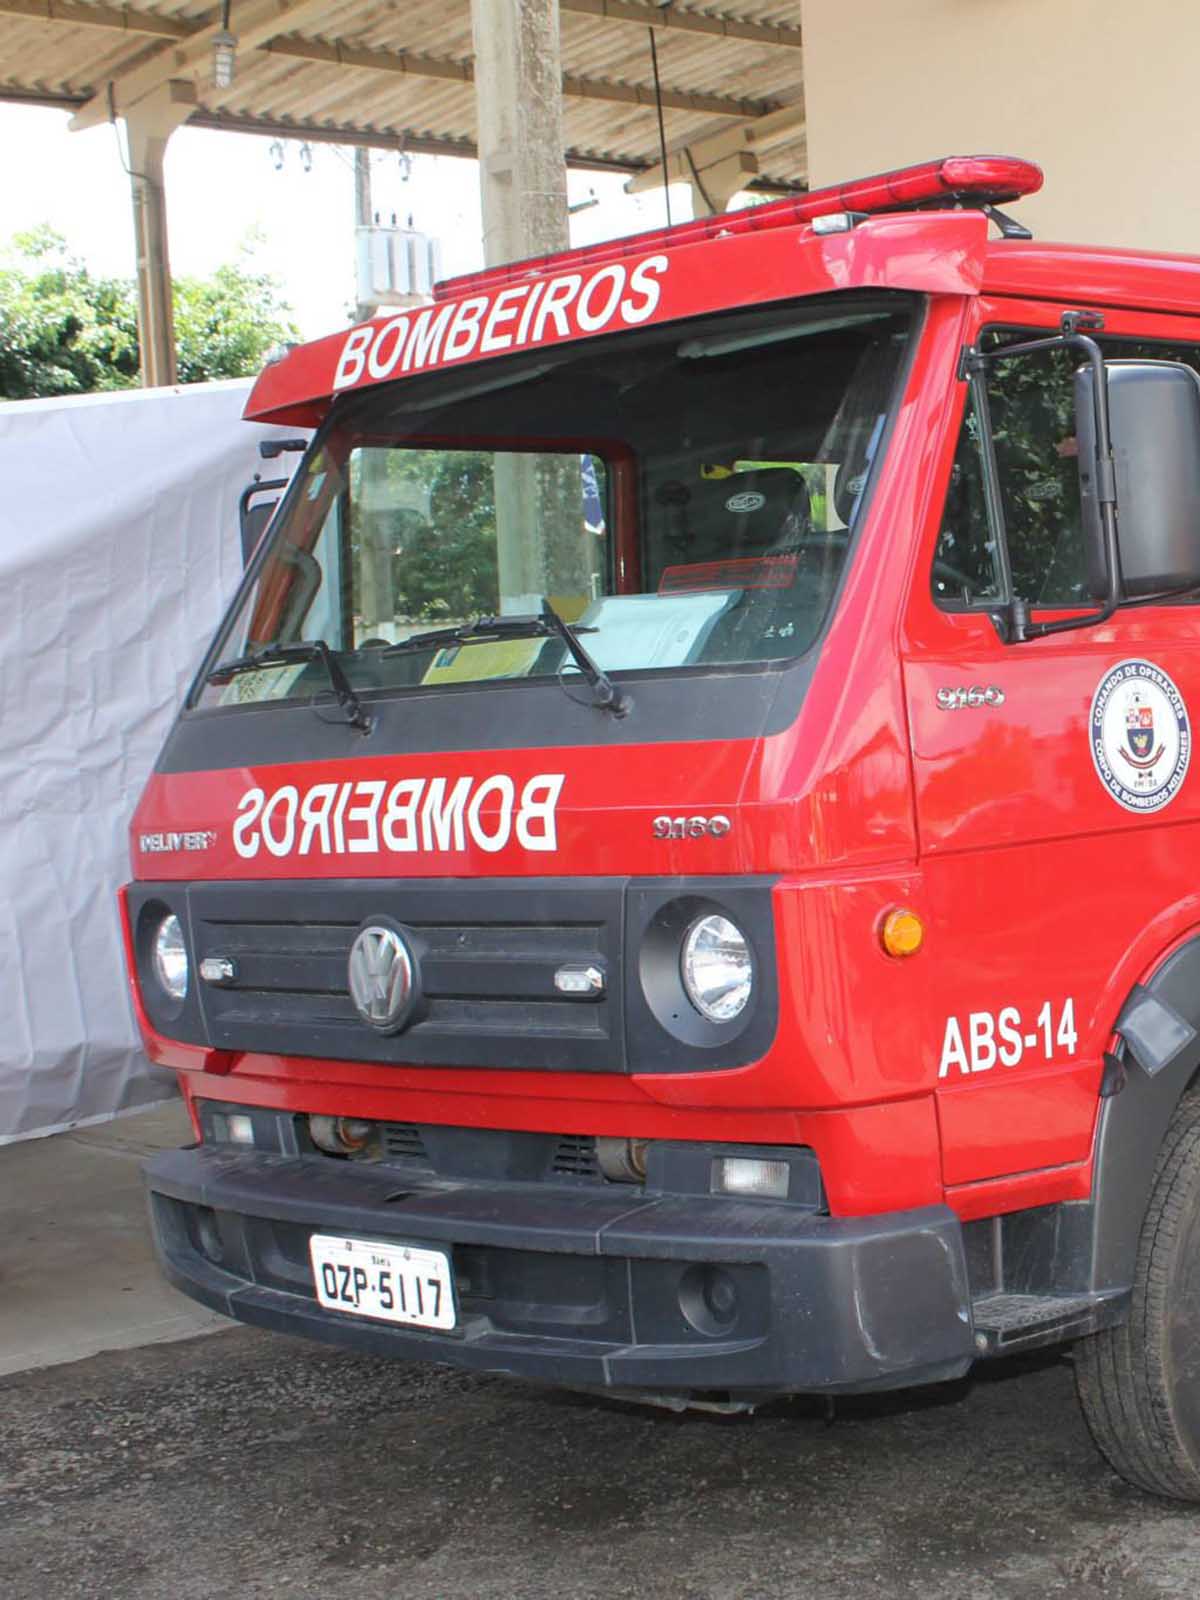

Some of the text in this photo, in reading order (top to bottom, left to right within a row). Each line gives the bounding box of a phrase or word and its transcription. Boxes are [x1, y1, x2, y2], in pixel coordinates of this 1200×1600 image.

[332, 255, 669, 390] BOMBEIROS
[1094, 670, 1124, 727] COMANDO
[1124, 665, 1138, 677] DE
[938, 997, 1078, 1078] ABS-14
